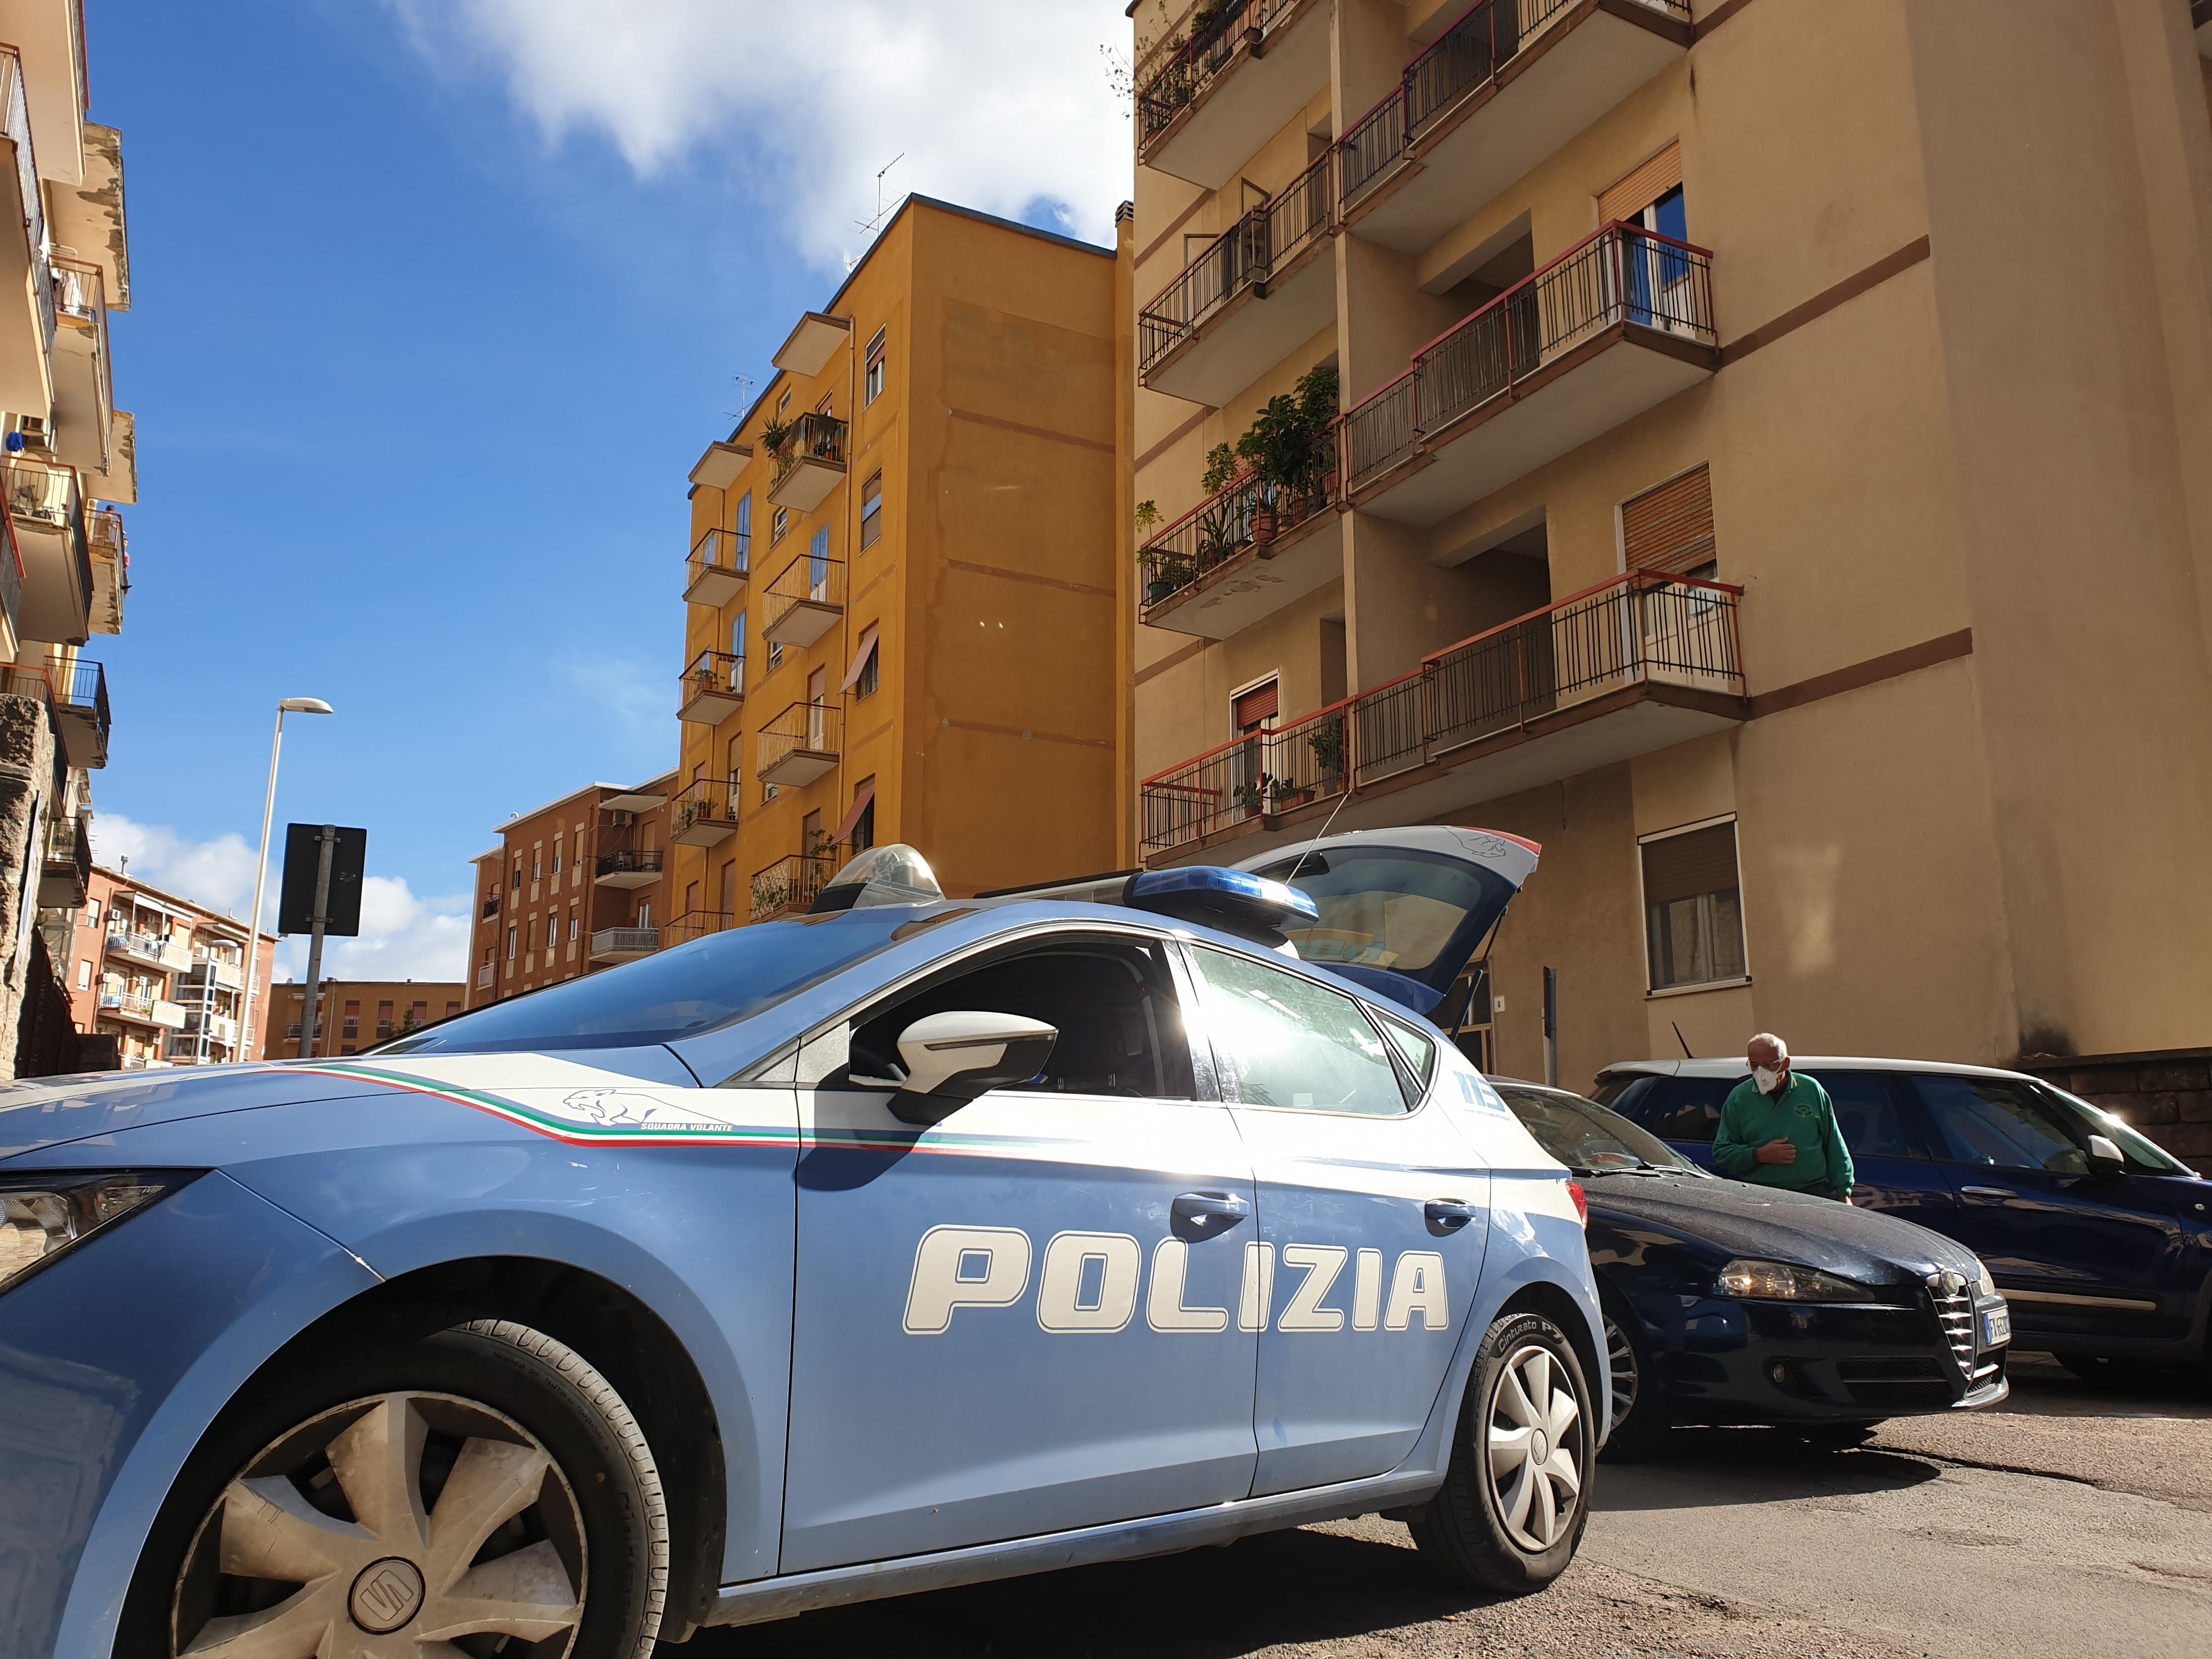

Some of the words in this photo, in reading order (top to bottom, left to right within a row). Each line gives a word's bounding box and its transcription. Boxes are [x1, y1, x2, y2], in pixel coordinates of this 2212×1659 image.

[1453, 1070, 1505, 1112] 113
[690, 1124, 733, 1132] VOLANTE
[902, 1224, 1449, 1335] POLIZIA
[1542, 1321, 1562, 1339] P7
